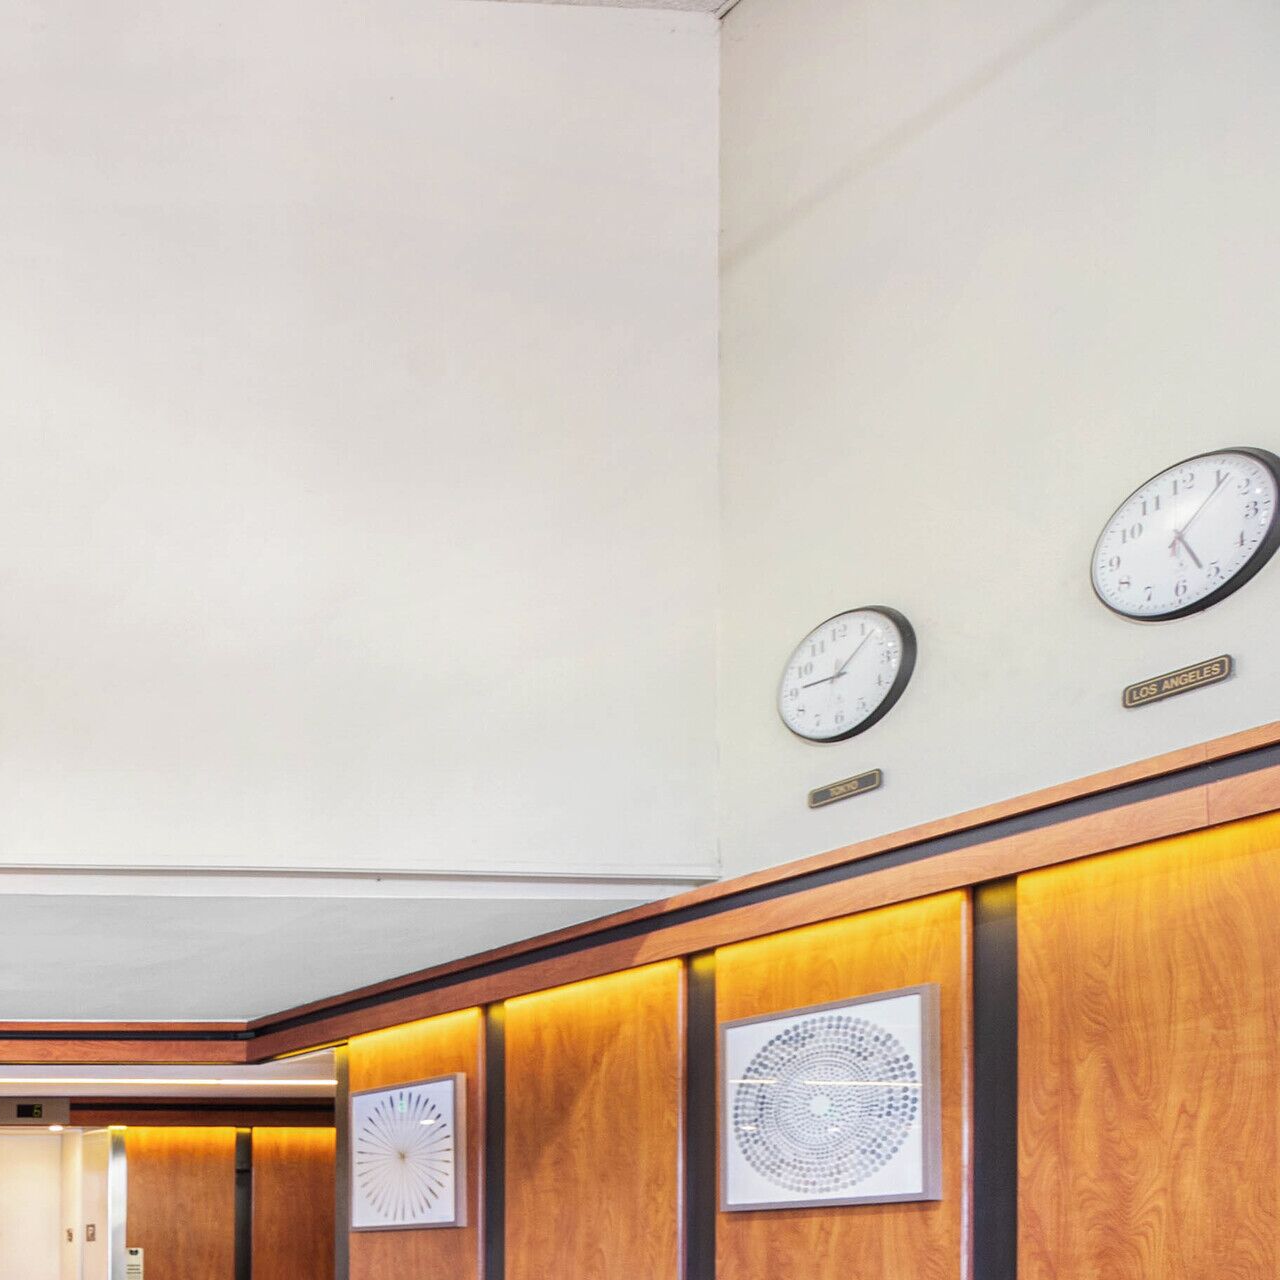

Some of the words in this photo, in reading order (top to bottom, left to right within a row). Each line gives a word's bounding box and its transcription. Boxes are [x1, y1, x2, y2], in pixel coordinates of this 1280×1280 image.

[1172, 472, 1195, 495] 12
[1237, 478, 1250, 496] 2
[1141, 495, 1160, 516] 11
[1245, 501, 1259, 518] 3
[1121, 522, 1144, 544] 10
[1109, 555, 1121, 572] 9
[1207, 560, 1220, 579] 5
[1144, 585, 1153, 601] 7
[1174, 579, 1188, 597] 6
[1132, 683, 1158, 701] LOS
[1162, 663, 1221, 691] ANGELES
